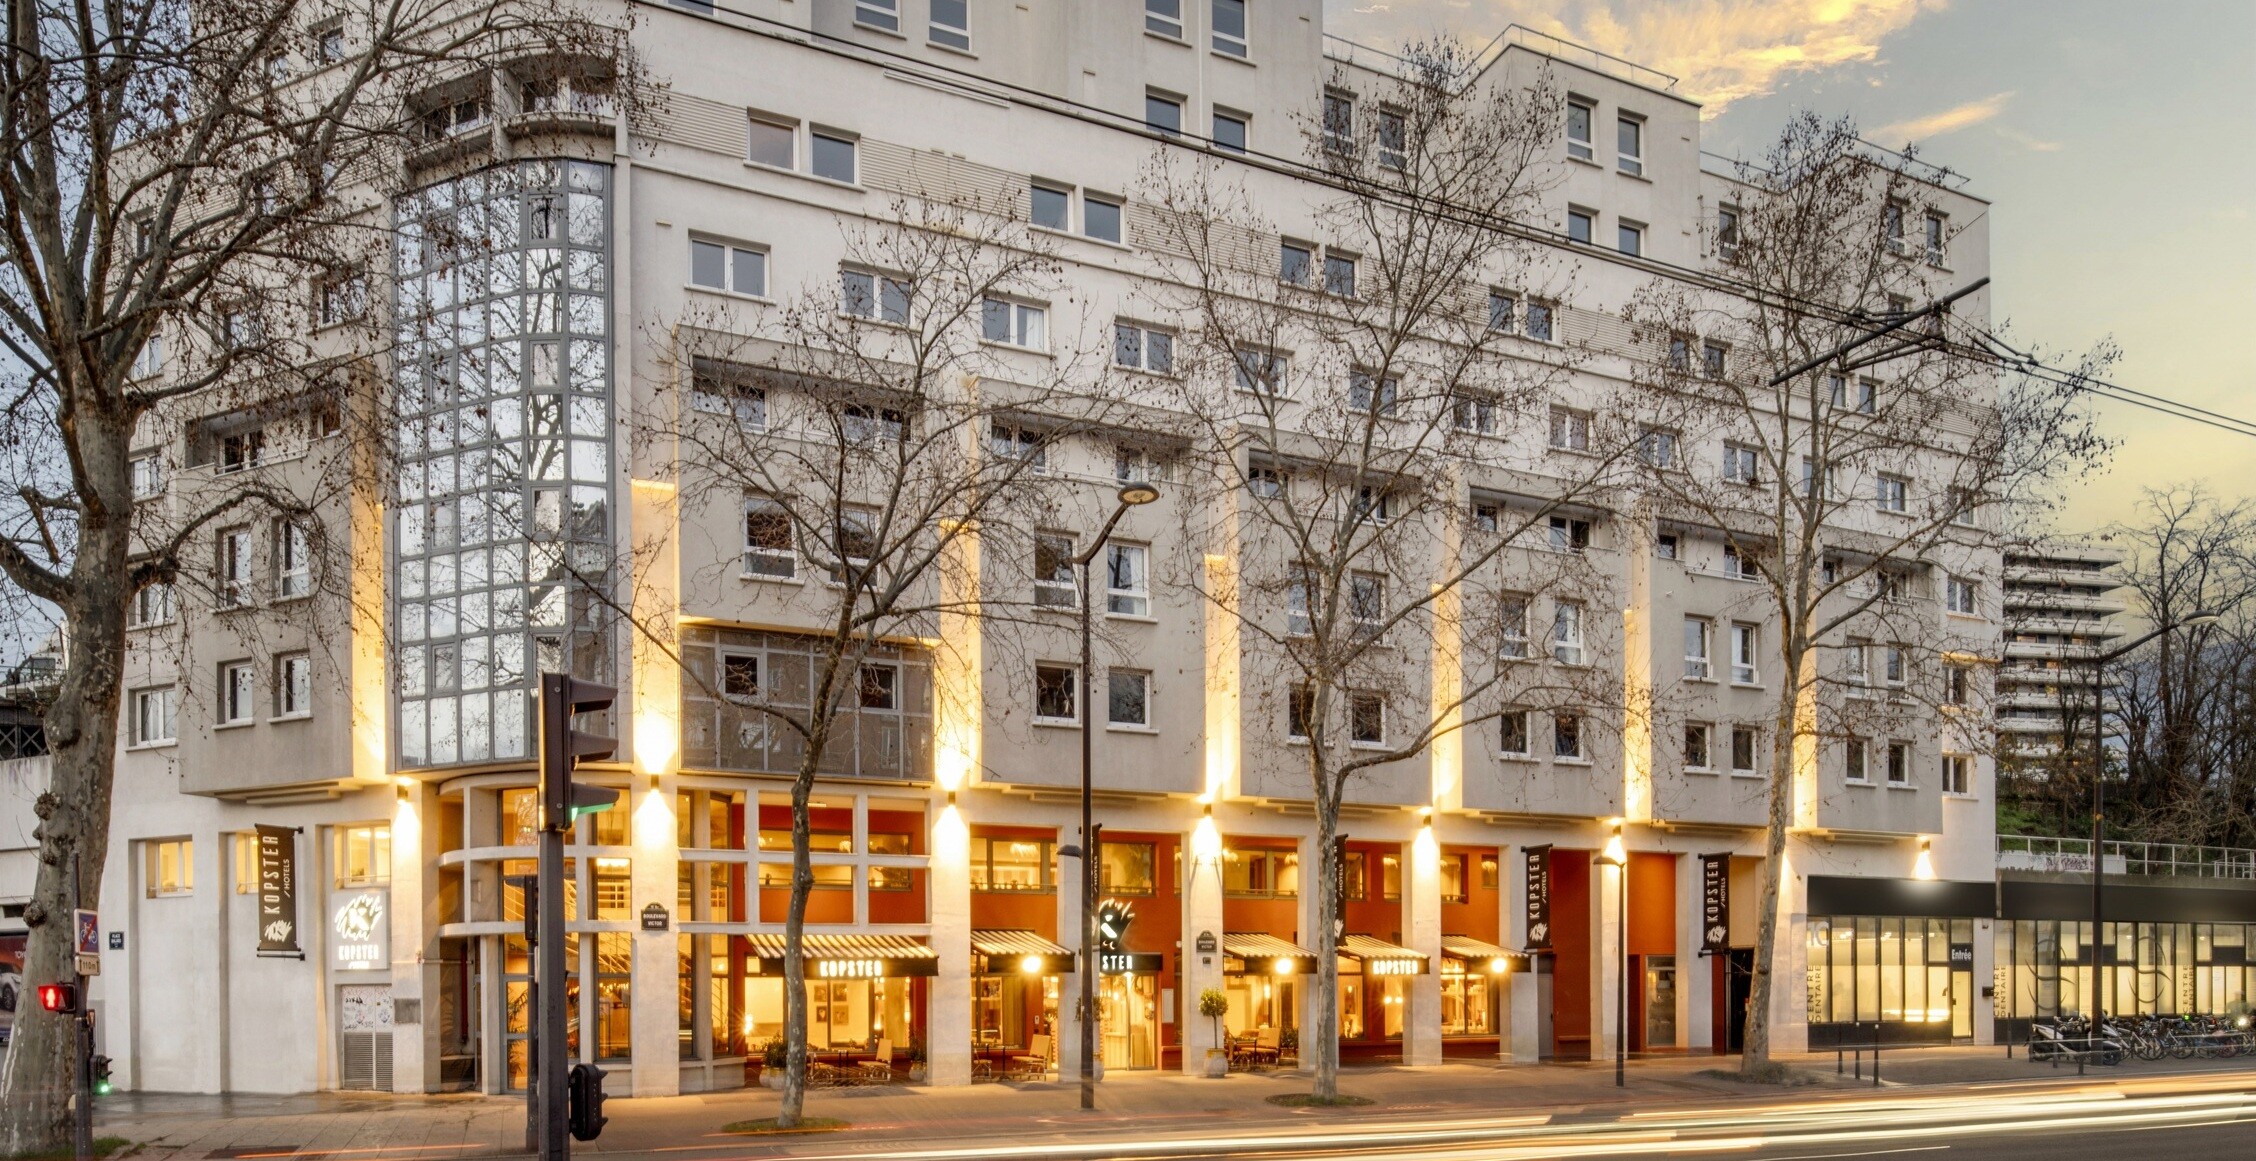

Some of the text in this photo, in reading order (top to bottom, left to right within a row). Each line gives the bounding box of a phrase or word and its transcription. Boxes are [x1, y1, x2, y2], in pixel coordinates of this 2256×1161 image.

[263, 836, 280, 914] KOPSTER
[1529, 854, 1540, 920] KOPSTER
[1707, 861, 1719, 922] KOPSTER
[1102, 955, 1133, 971] STER
[1951, 948, 1972, 961] Entrée
[1806, 964, 1815, 1024] CENTRE
